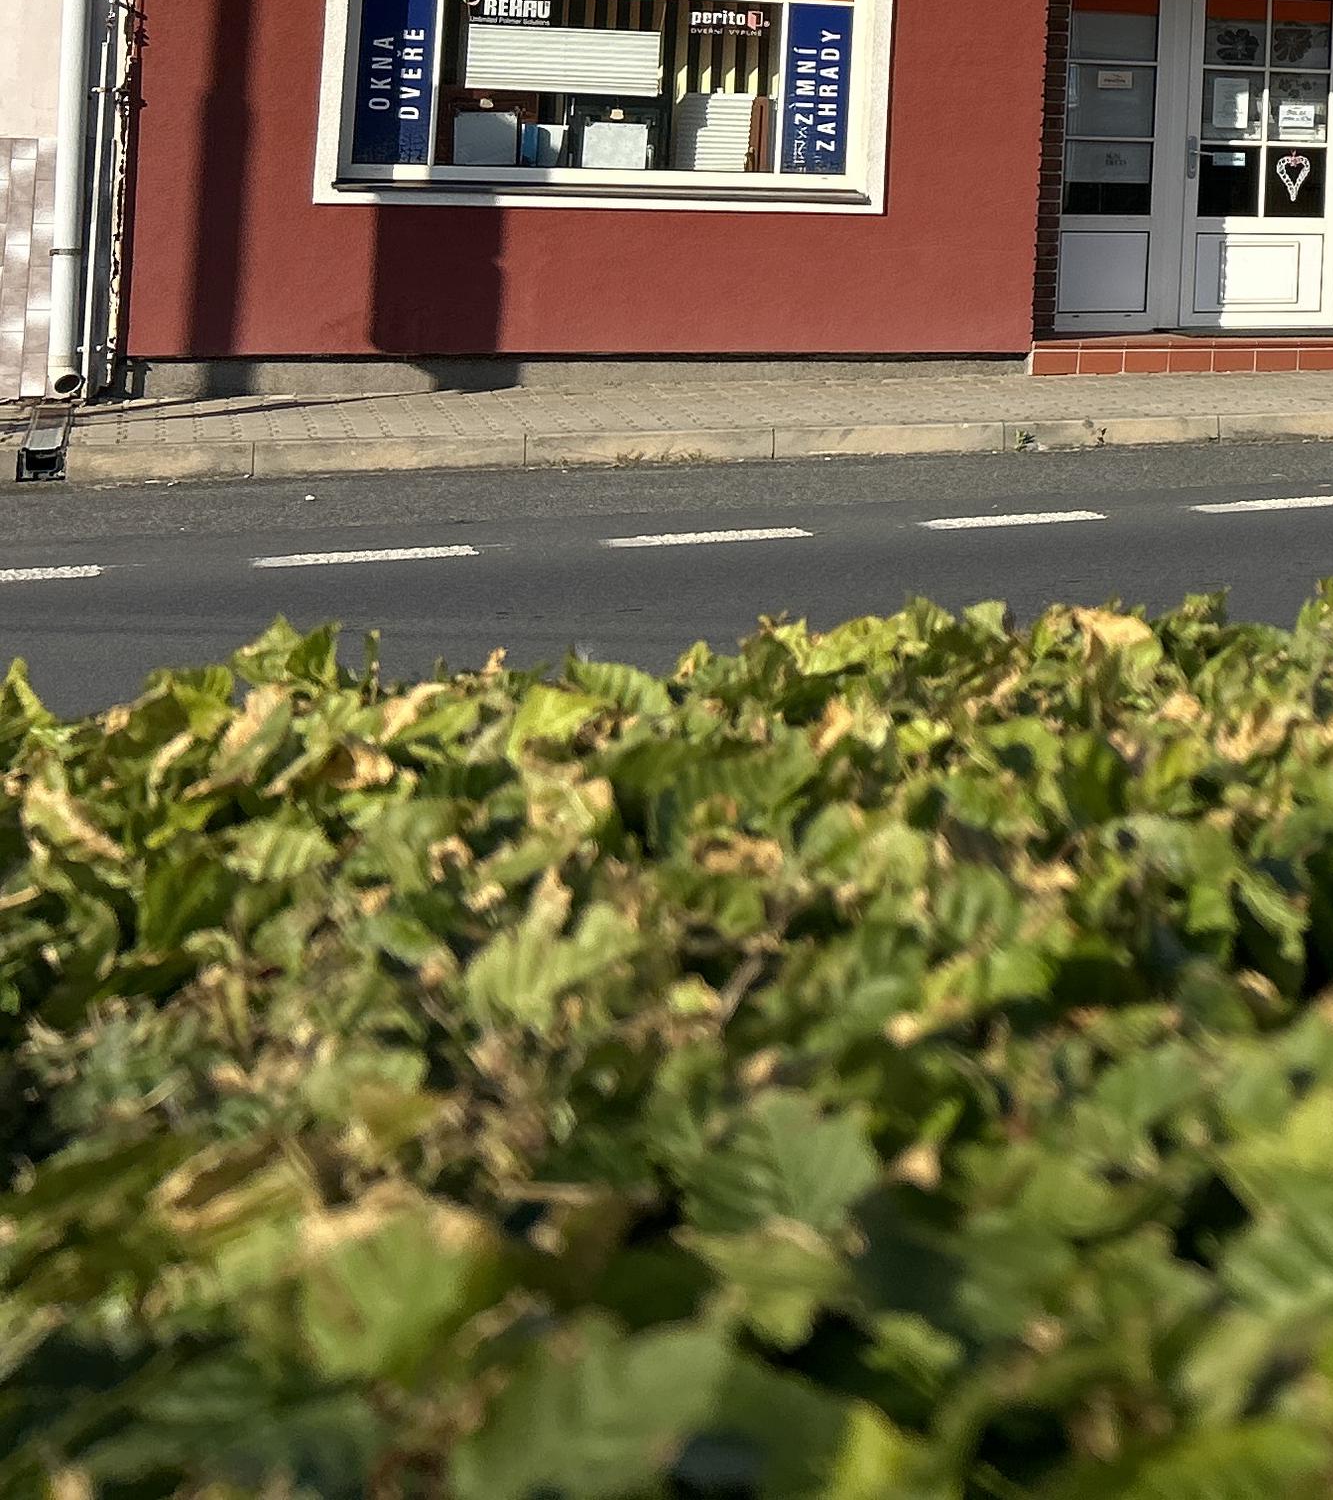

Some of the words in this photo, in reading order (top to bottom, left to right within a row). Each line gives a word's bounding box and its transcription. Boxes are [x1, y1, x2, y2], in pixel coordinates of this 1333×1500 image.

[691, 9, 746, 26] perito
[368, 36, 395, 111] OKNA
[397, 29, 426, 120] DVEŘE
[816, 29, 841, 152] ZAHRADY
